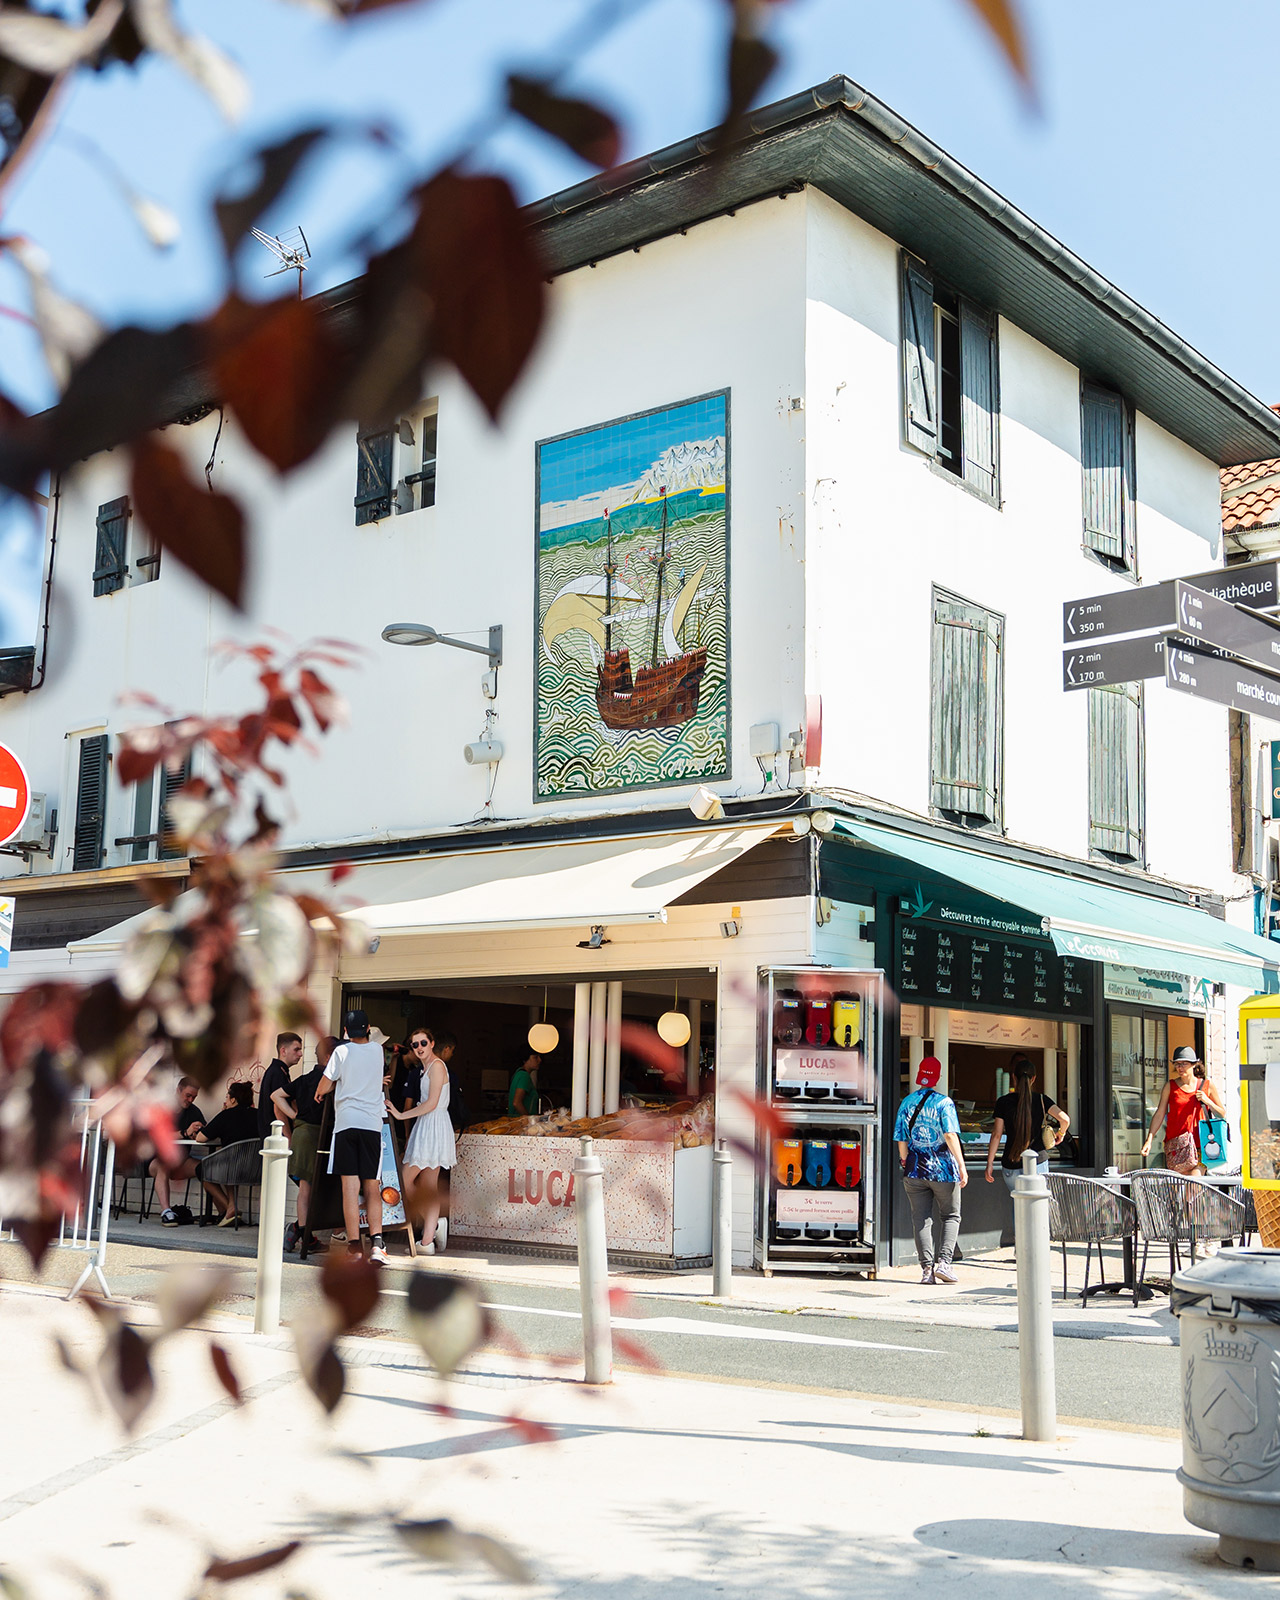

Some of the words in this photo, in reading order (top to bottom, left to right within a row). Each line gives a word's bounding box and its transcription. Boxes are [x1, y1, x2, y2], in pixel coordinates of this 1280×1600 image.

[1187, 594, 1194, 605] 1
[1193, 597, 1203, 610] min
[1079, 607, 1085, 616] 5
[1086, 604, 1102, 615] min
[1079, 623, 1095, 634] 350
[1096, 621, 1105, 631] m
[1196, 621, 1203, 631] m
[1078, 655, 1085, 664] 2
[1086, 652, 1102, 663] min
[1178, 650, 1184, 662] 4
[1183, 654, 1195, 666] min
[1079, 671, 1095, 682] 170
[1096, 670, 1105, 680] m
[1190, 678, 1198, 688] m
[1236, 681, 1266, 701] marché
[799, 1057, 836, 1069] LUCAS
